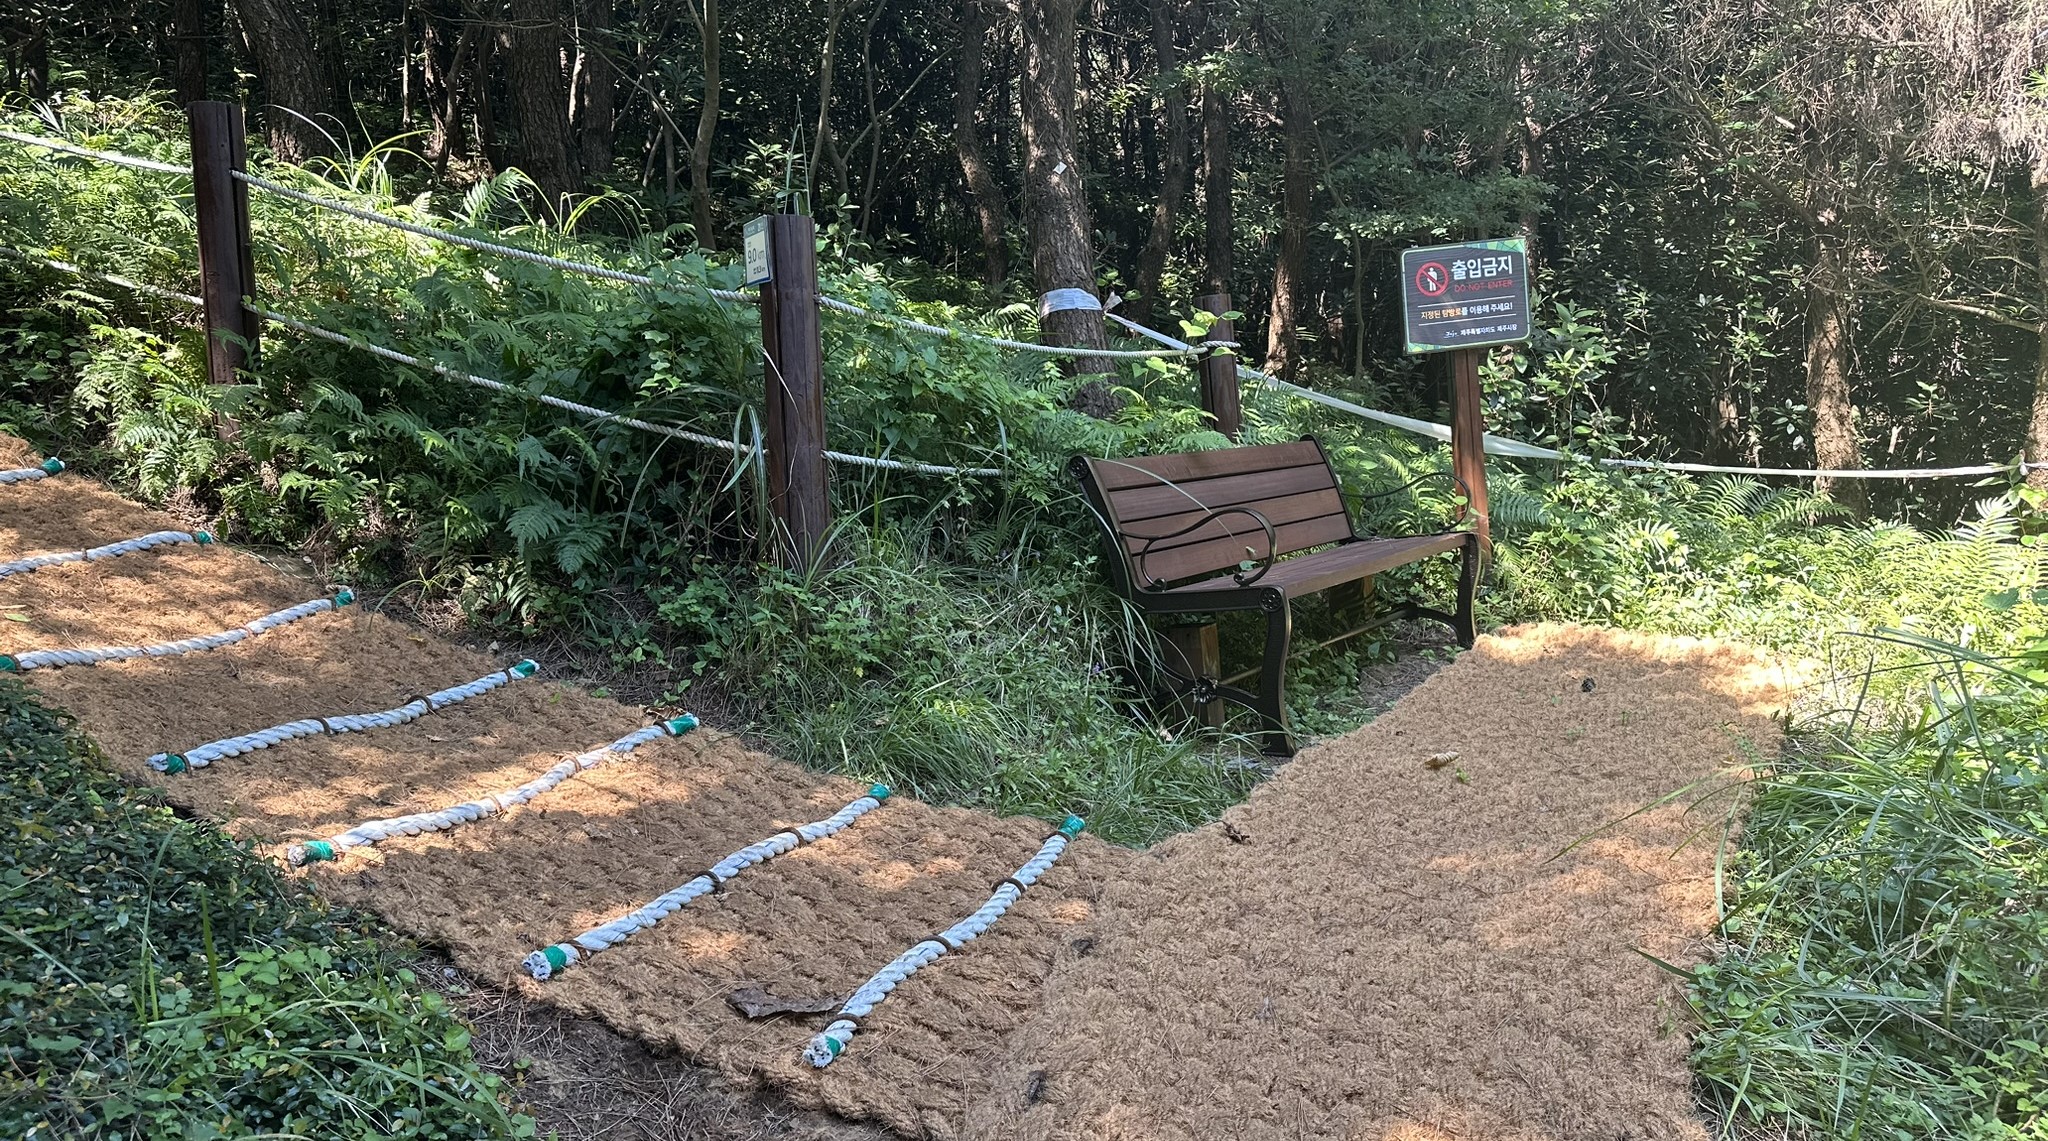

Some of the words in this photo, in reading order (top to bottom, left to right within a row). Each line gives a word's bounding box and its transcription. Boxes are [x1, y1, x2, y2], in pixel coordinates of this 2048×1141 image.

[1451, 255, 1513, 280] 출입금지
[1454, 284, 1466, 293] DO
[1468, 282, 1486, 292] NOT
[1487, 279, 1514, 290] ENTER
[1421, 309, 1441, 320] 지정된
[1441, 306, 1468, 318] 탐방로를
[1469, 304, 1490, 316] 이용해
[1490, 301, 1513, 313] 주세요!
[1460, 326, 1496, 337] 제주특별자치도
